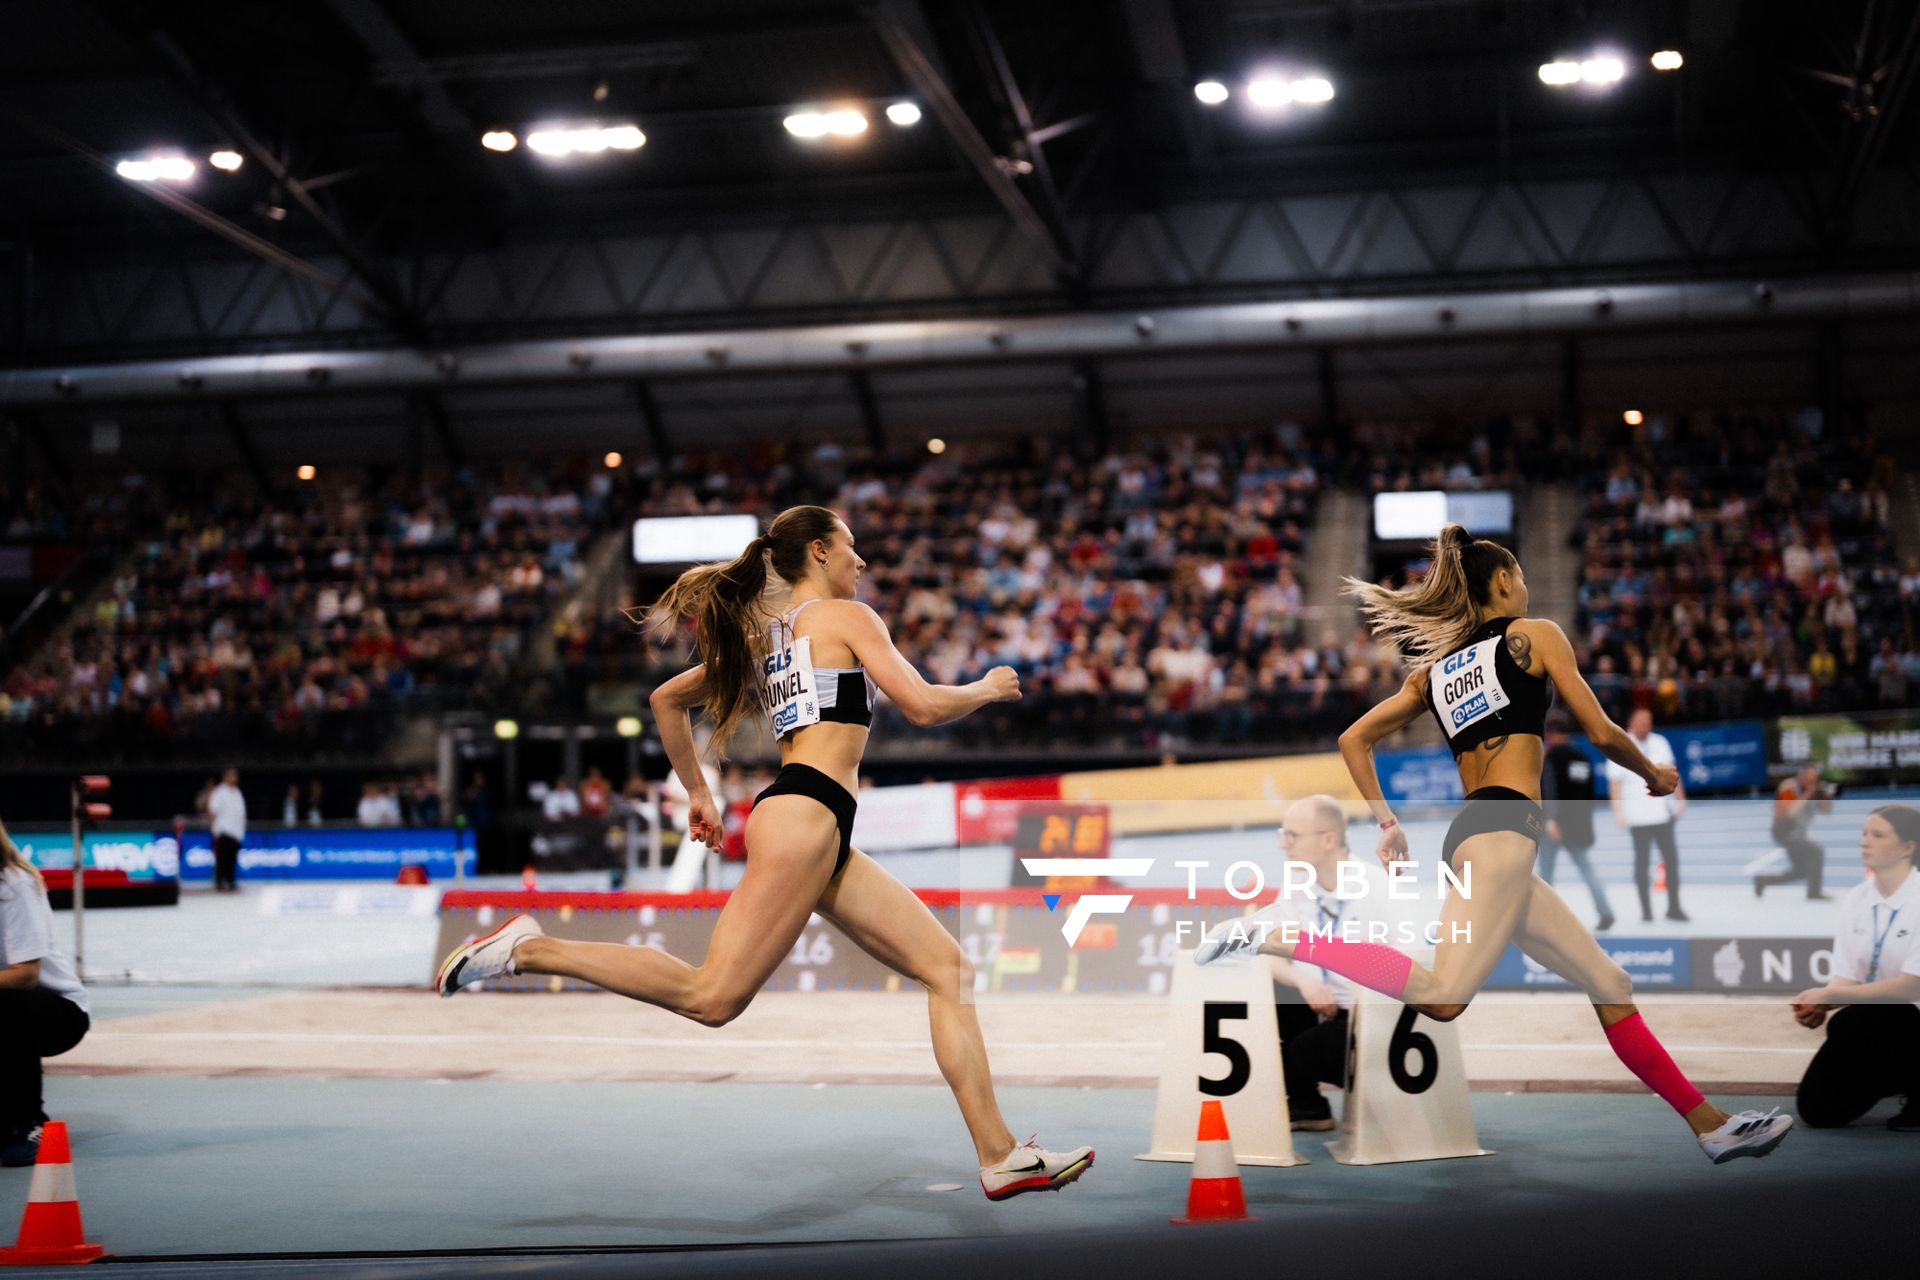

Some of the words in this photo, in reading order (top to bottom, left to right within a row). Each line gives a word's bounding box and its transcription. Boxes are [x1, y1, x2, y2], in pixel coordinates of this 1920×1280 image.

[764, 647, 792, 675] GLS
[1444, 646, 1478, 675] GLS
[1444, 665, 1484, 705] GORR
[1464, 695, 1486, 714] PLAN
[789, 932, 834, 966] 16
[1198, 1001, 1251, 1097] 5
[1388, 1003, 1439, 1095] 6
